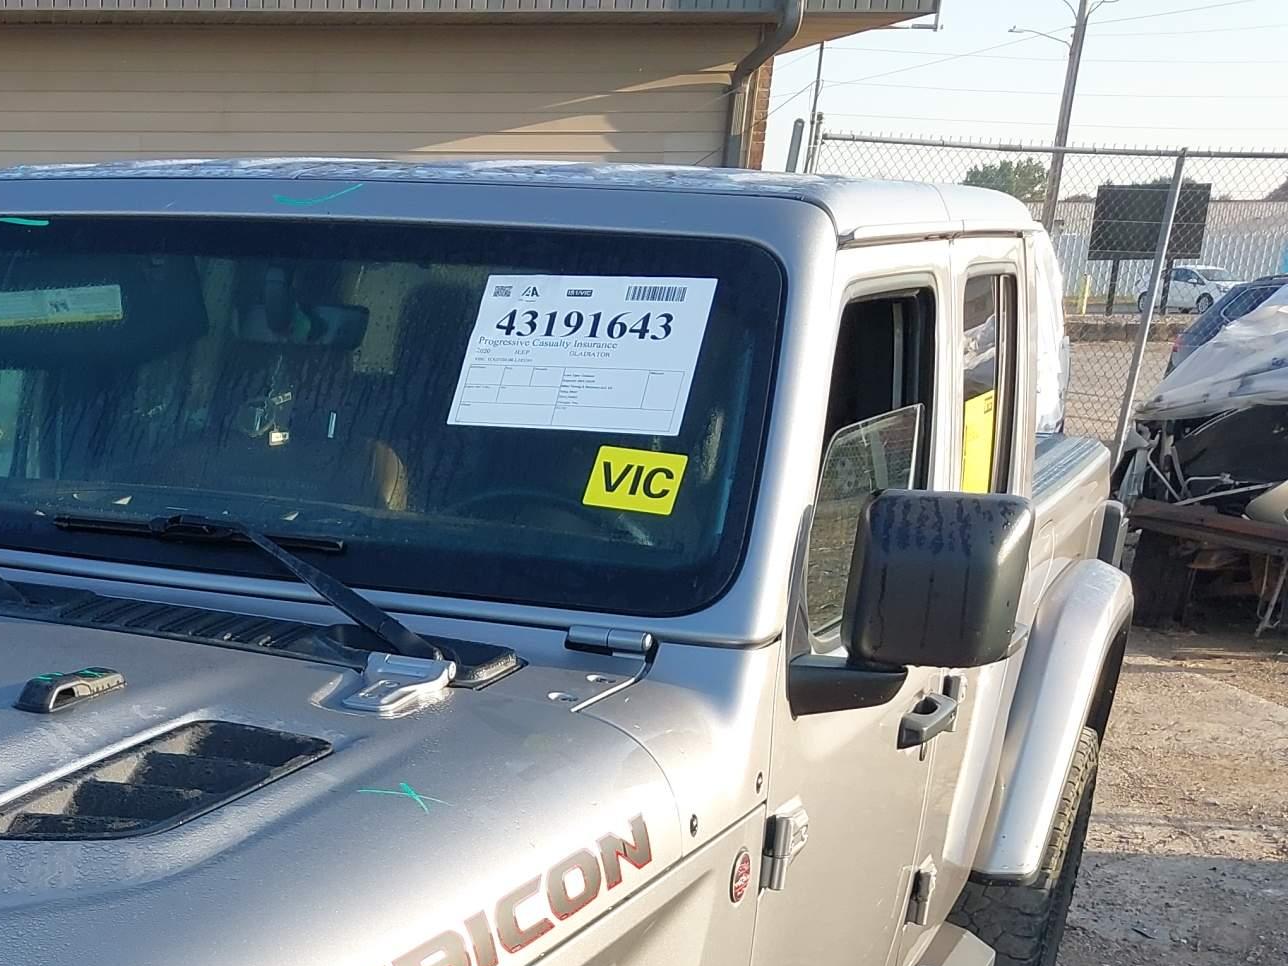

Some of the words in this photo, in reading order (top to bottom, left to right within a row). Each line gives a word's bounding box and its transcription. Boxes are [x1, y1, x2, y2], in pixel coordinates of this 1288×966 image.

[495, 308, 675, 341] 43191643
[478, 335, 530, 349] Progressive
[532, 339, 571, 349] Casualty
[574, 340, 619, 349] Insurance
[602, 461, 674, 499] VIC
